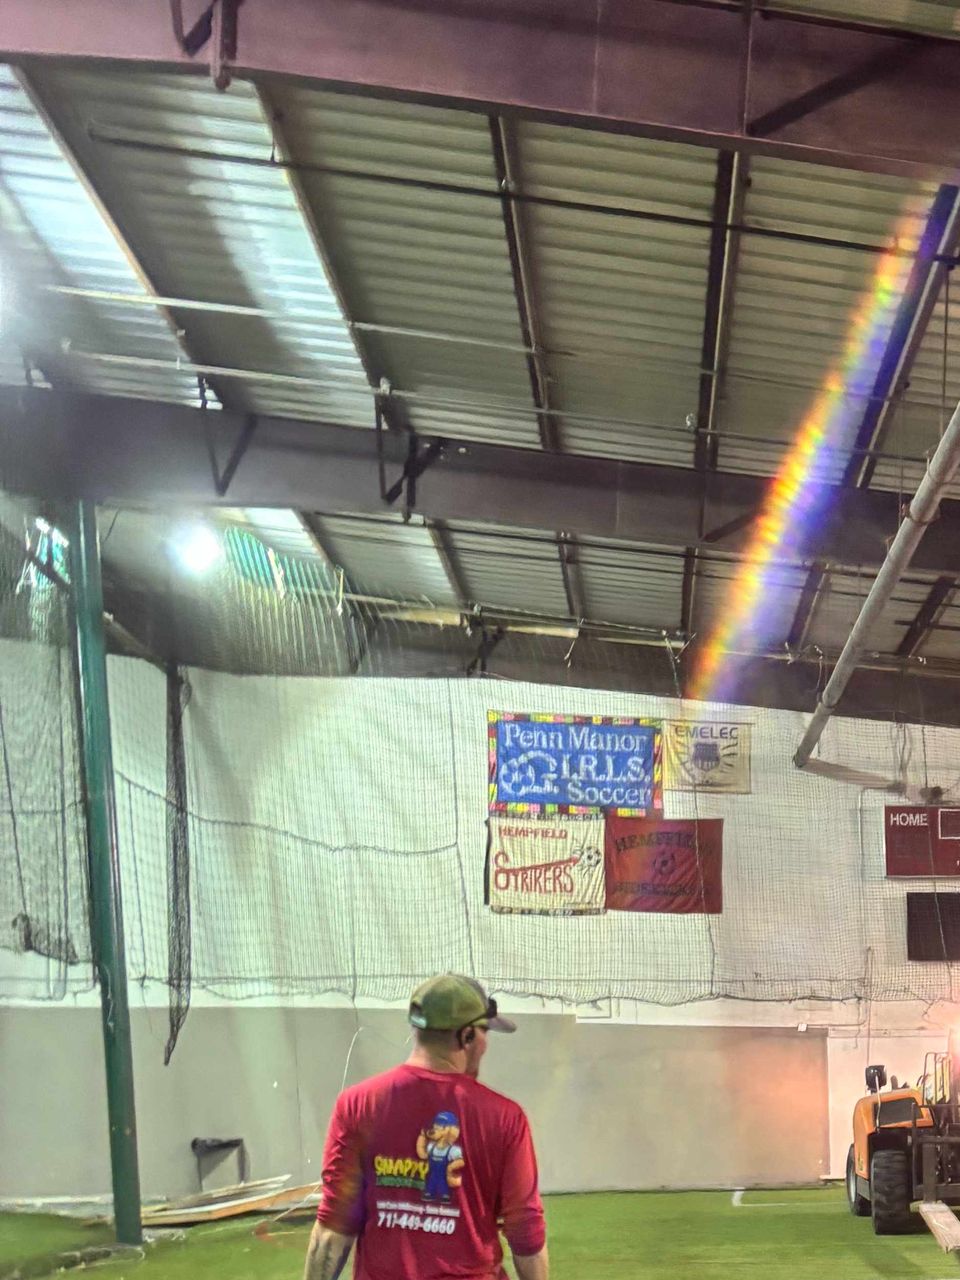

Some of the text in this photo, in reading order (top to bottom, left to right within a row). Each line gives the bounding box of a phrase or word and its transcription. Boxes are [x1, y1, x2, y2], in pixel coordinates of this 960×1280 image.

[504, 723, 647, 752] Penn Manor
[675, 726, 739, 740] EMELEC
[567, 779, 650, 805] Soccer
[890, 813, 929, 826] HOME
[498, 826, 568, 840] HEMPFIELD
[494, 850, 577, 894] STRIKERS
